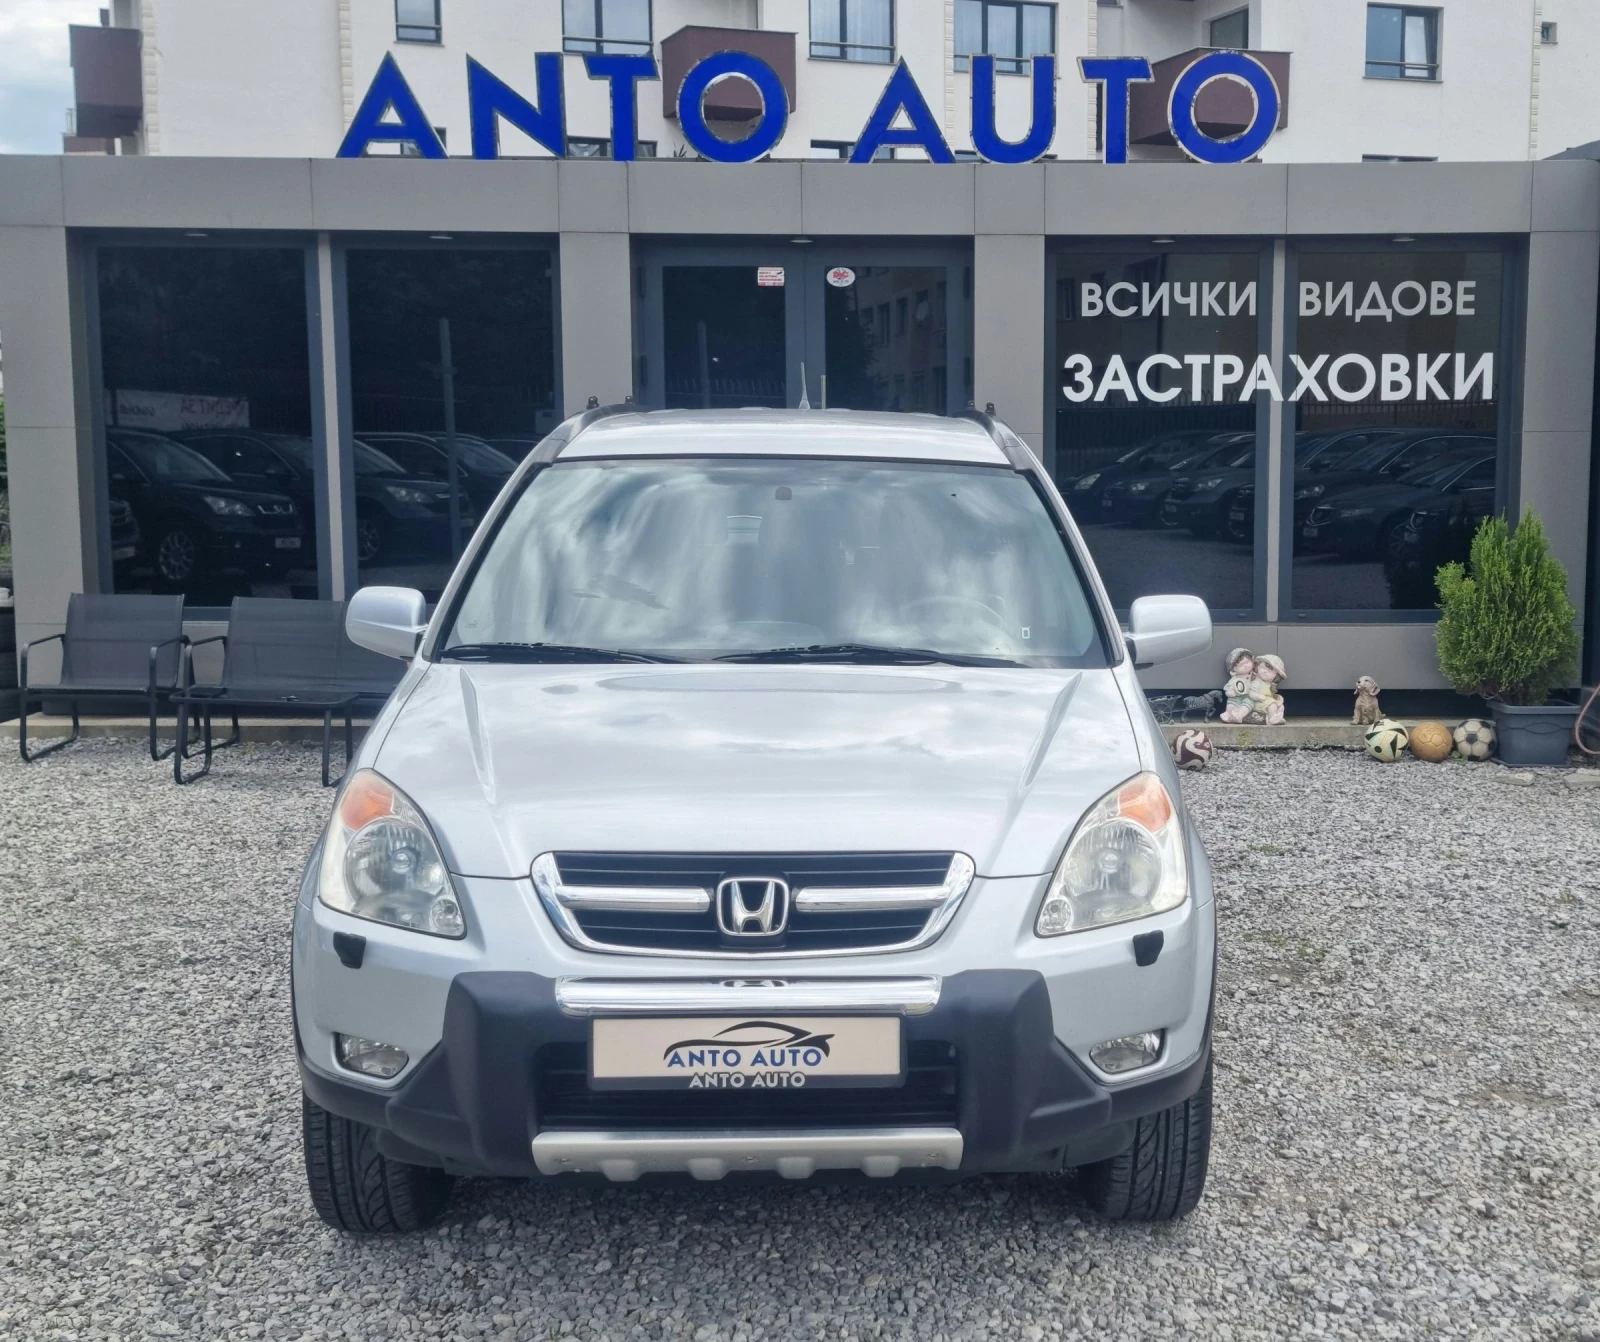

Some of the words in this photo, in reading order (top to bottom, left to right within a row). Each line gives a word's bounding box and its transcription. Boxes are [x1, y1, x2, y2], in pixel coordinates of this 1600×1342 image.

[335, 50, 790, 163] ANTO
[848, 50, 1282, 164] AUTO
[1081, 280, 1257, 318] ВСИЧКИ
[1299, 280, 1477, 322] ВИДОВЕ
[1062, 352, 1494, 402] ЗАСТРАХОВКИ
[667, 1049, 741, 1067] ANTO
[750, 1049, 822, 1067] AUTO
[689, 1072, 745, 1088] ANTO
[751, 1072, 806, 1088] AUTO
